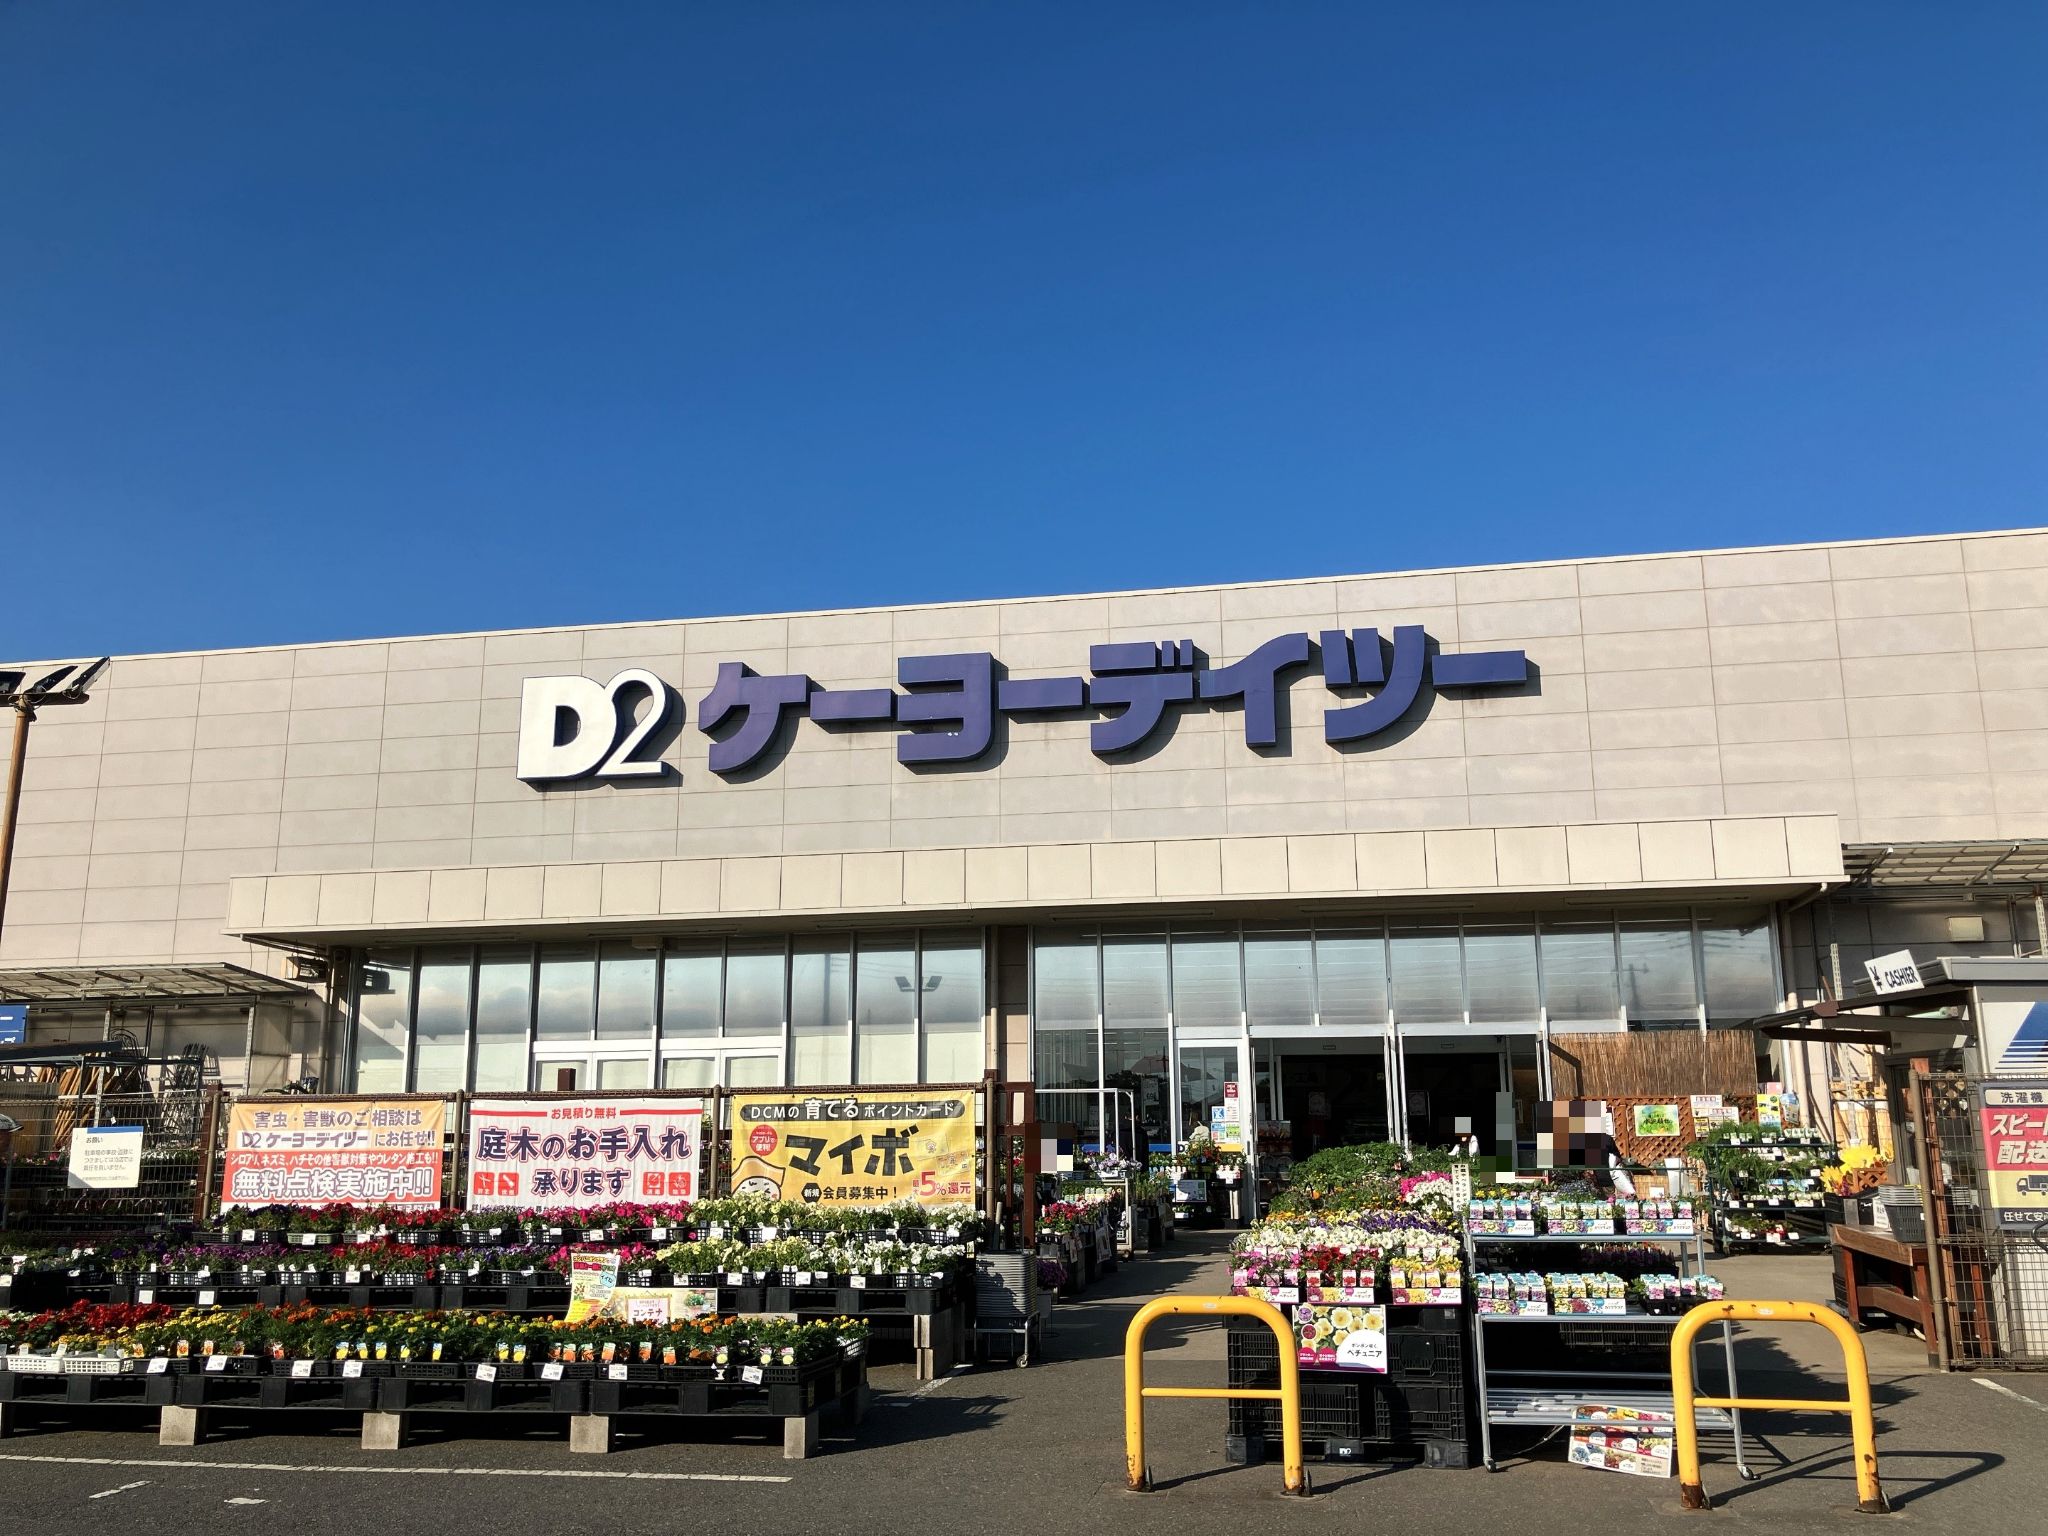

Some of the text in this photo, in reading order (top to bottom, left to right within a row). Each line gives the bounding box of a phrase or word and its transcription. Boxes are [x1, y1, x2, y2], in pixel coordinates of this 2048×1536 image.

[515, 624, 1528, 781] D2 ケーヨーデイツー
[1884, 965, 1919, 988] CASHIER
[2000, 1091, 2044, 1104] 洗濯機
[551, 1107, 616, 1119] お見積り無料
[1989, 1113, 2048, 1136] スピー
[476, 1125, 692, 1162] 庭木のお手入れ
[785, 1124, 920, 1176] マイボ
[1996, 1140, 2048, 1165] 配送
[232, 1167, 433, 1199] 無料点検実施中!!
[531, 1167, 631, 1197] 承ります
[633, 1308, 663, 1317] コンテナ
[1347, 1349, 1383, 1358] ペチュニア
